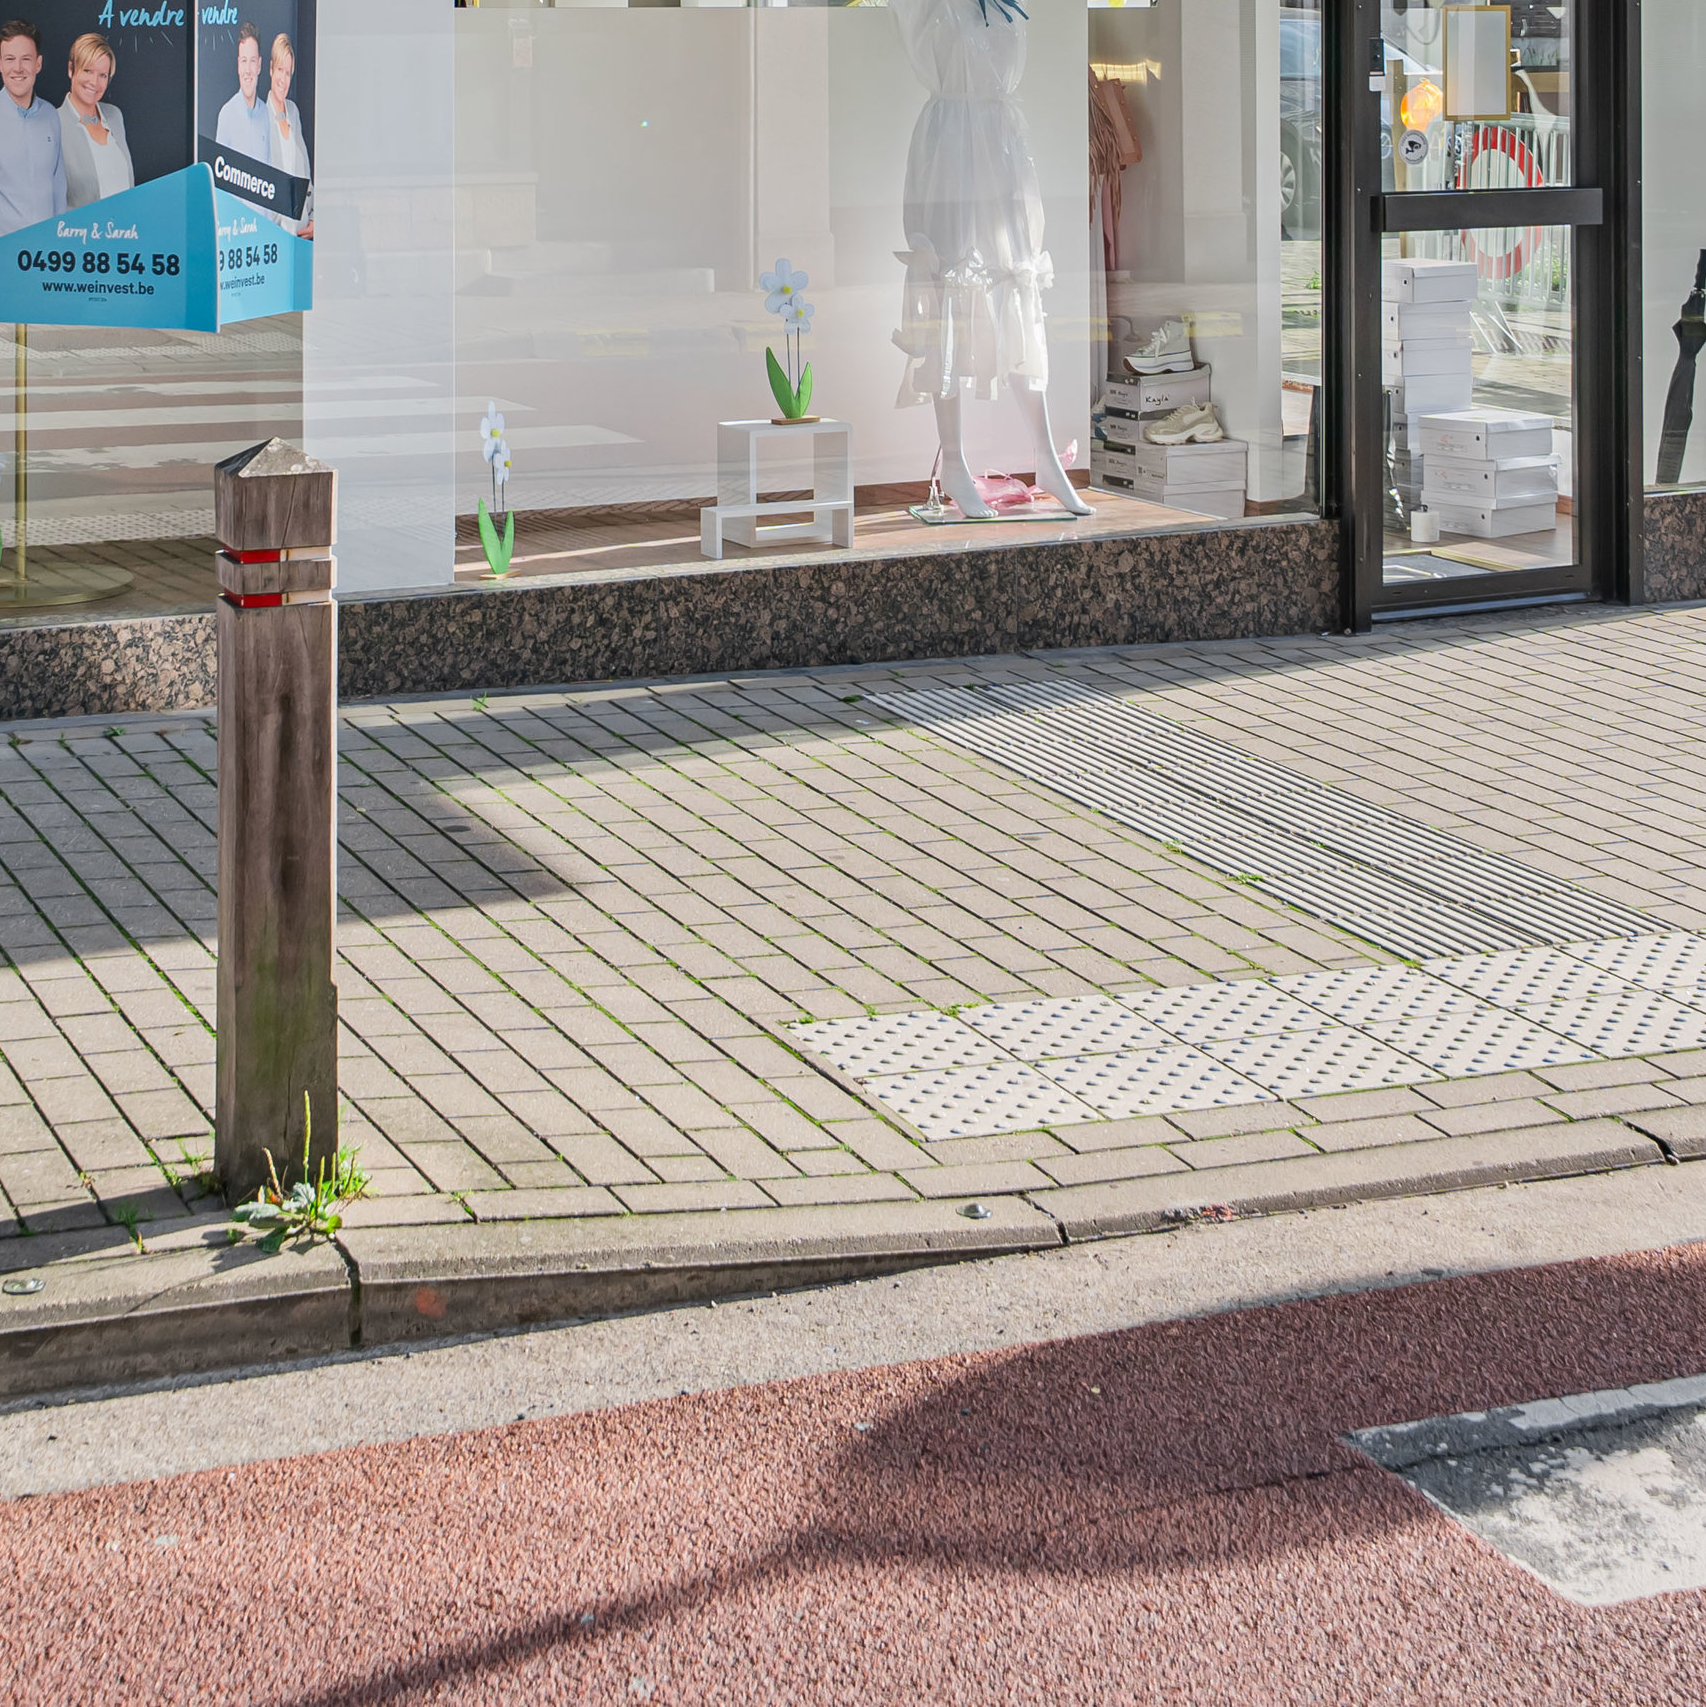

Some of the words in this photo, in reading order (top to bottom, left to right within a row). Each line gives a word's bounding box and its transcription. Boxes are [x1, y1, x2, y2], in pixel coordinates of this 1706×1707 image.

[120, 0, 185, 27] vendre
[214, 155, 276, 200] Commerce
[57, 221, 87, 245] Barry
[91, 222, 102, 239] &
[105, 220, 139, 240] Sarah
[218, 220, 232, 243] arry
[240, 217, 258, 234] Sarah
[17, 250, 76, 273] 0499
[82, 251, 110, 274] 88
[117, 253, 145, 275] 54
[152, 254, 180, 276] 58
[228, 248, 243, 271] 88
[246, 245, 260, 267] 54
[263, 243, 278, 265] 58
[42, 280, 155, 295] www.weinvest.be
[1146, 394, 1169, 406] Kayla
